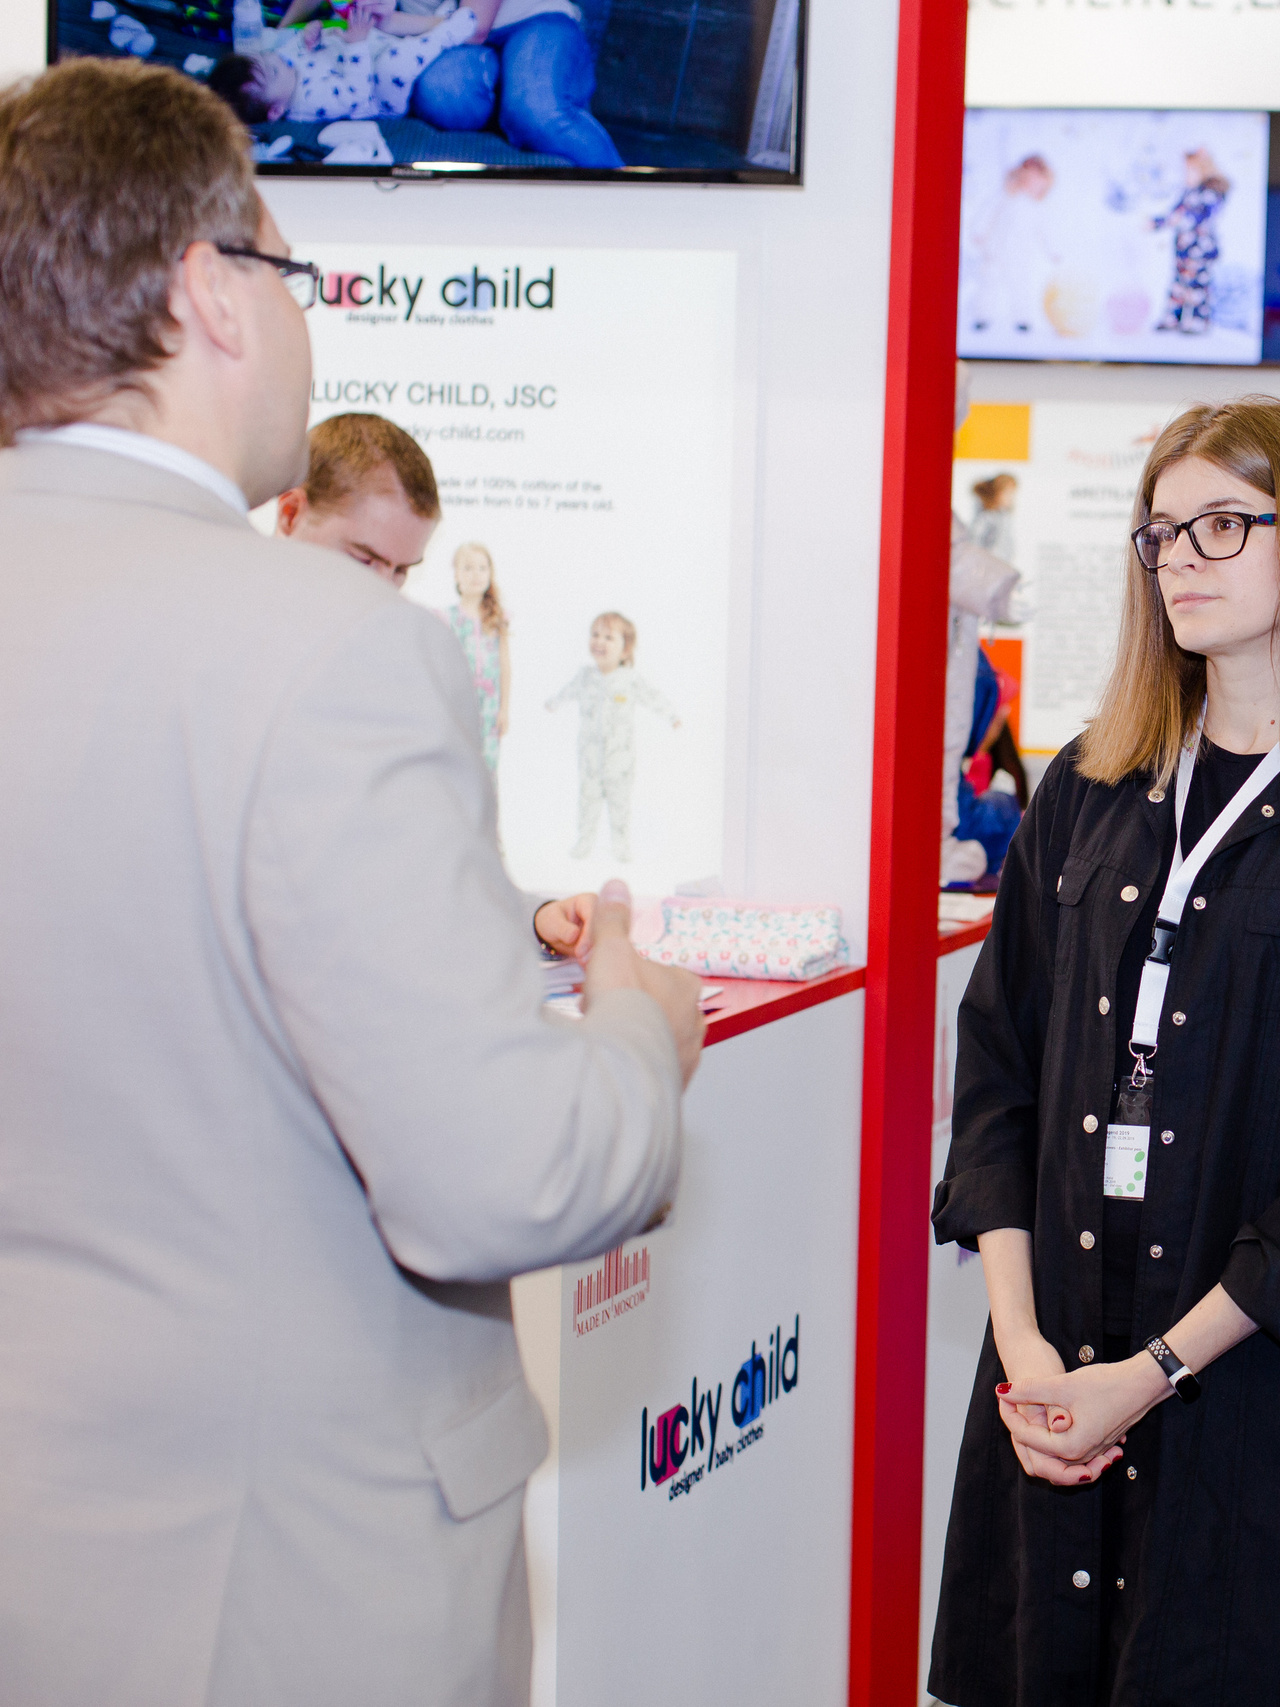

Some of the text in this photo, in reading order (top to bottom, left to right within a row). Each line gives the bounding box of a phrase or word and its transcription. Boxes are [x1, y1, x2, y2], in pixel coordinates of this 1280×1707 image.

[318, 264, 554, 321] ucky child
[311, 380, 558, 410] LUCKY CHILD, JSC
[576, 1290, 646, 1338] MADE IN MOSCOW
[641, 1313, 799, 1491] lucky child
[669, 1423, 764, 1501] designer baby clothes
